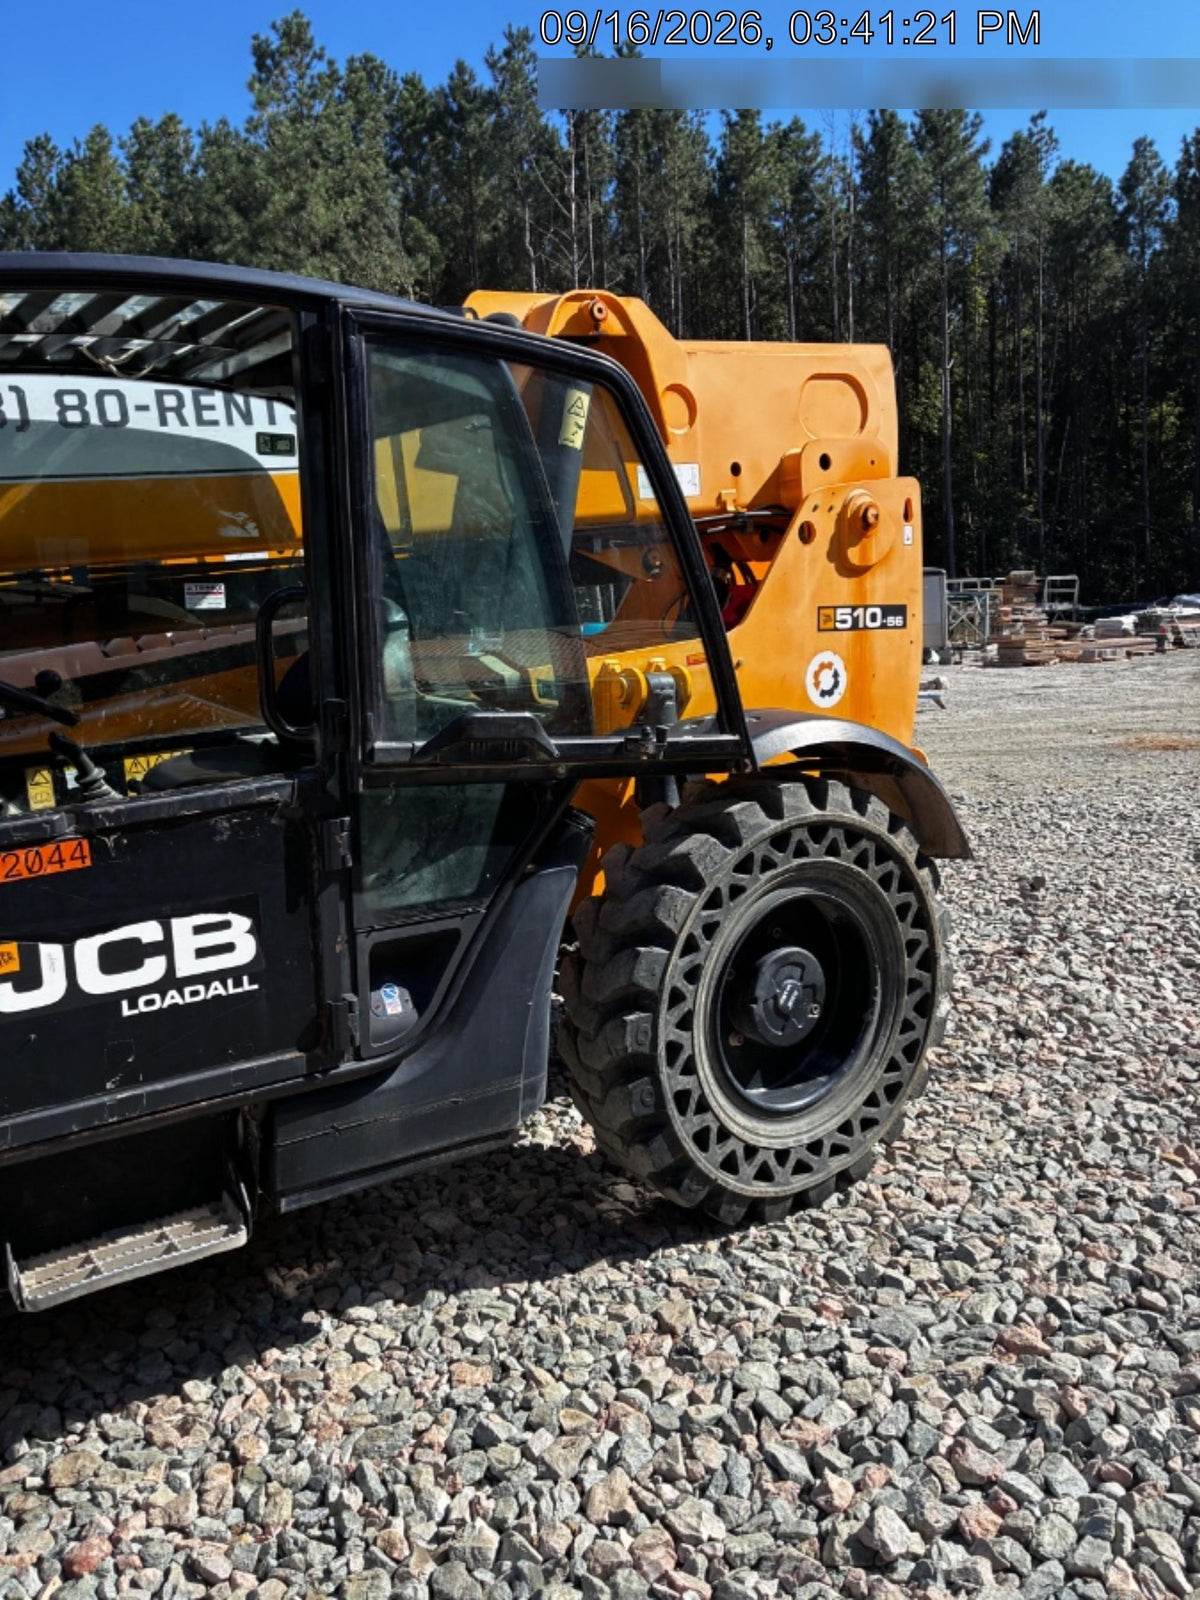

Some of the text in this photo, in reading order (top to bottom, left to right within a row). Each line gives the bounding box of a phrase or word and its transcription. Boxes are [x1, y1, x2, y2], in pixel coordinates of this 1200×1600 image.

[54, 388, 298, 428] 80-RENT
[2, 841, 87, 878] 2044
[0, 912, 257, 1013] JCB
[121, 975, 259, 1018] LOADALL
